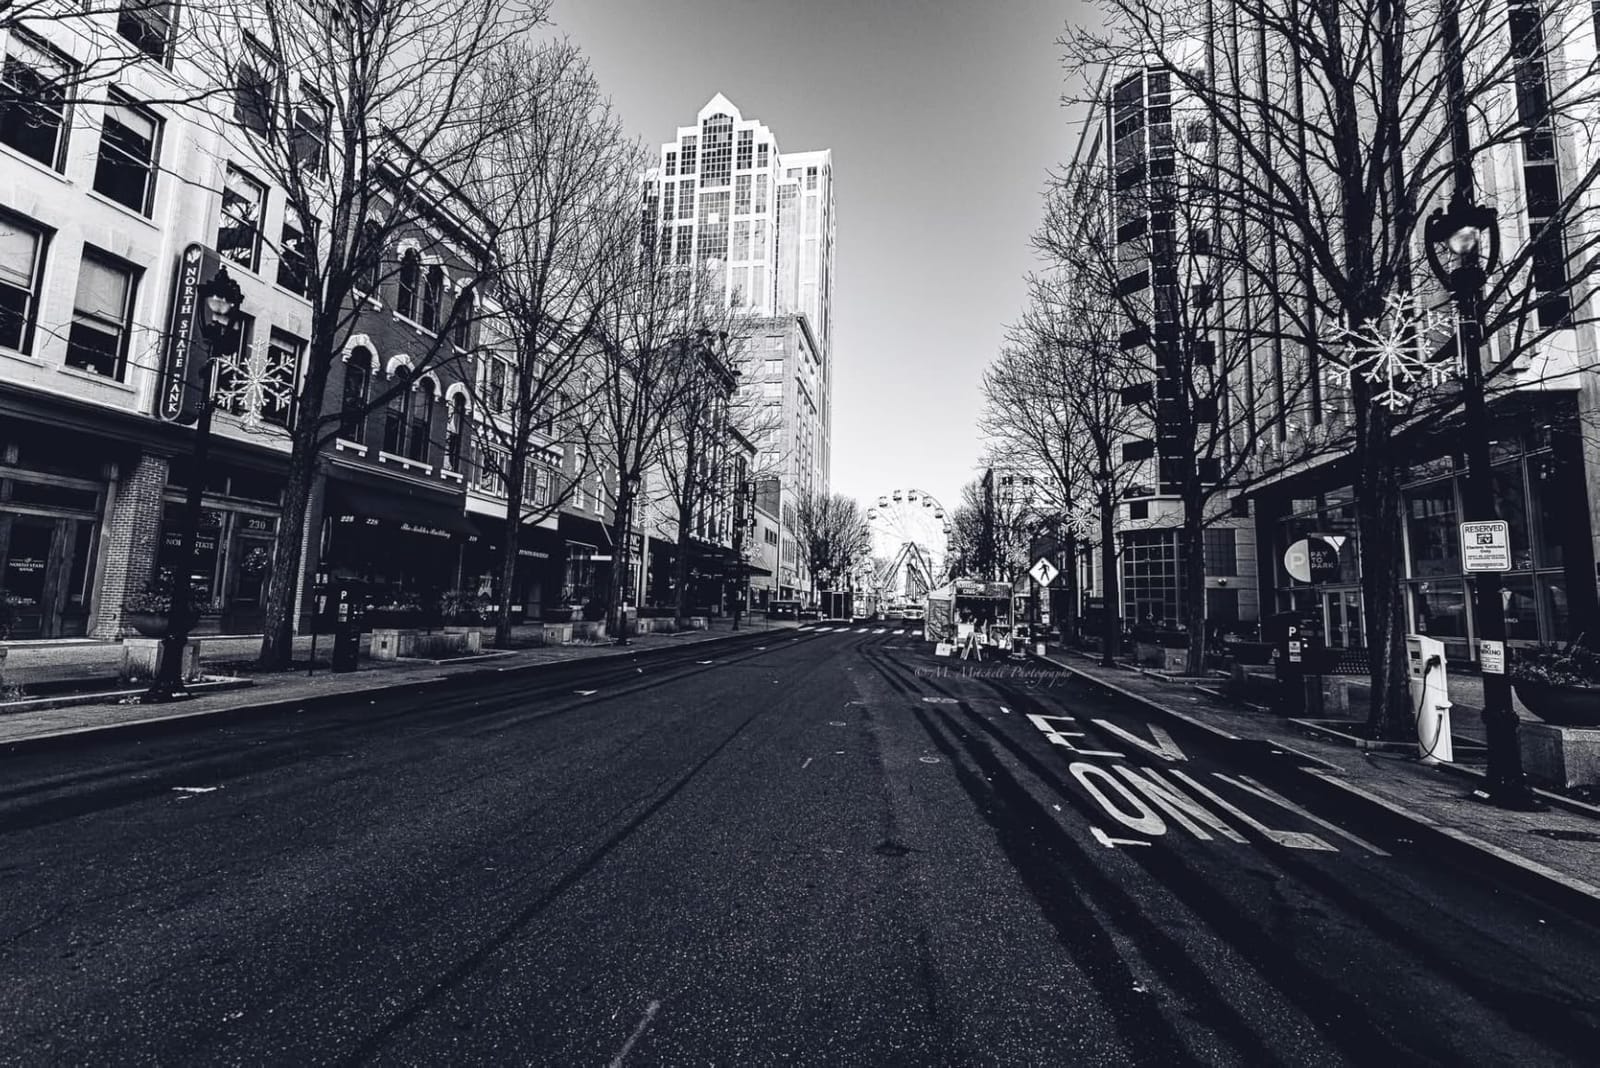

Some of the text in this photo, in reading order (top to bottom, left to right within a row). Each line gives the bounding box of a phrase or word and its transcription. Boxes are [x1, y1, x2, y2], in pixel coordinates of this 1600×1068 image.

[180, 267, 197, 315] NORTH
[176, 320, 189, 368] STATE
[248, 519, 267, 529] 230
[1465, 525, 1503, 533] RESERVED
[341, 590, 348, 600] P
[1288, 626, 1297, 637] P
[1026, 713, 1189, 762] EV
[1068, 762, 1392, 857] ONLY
